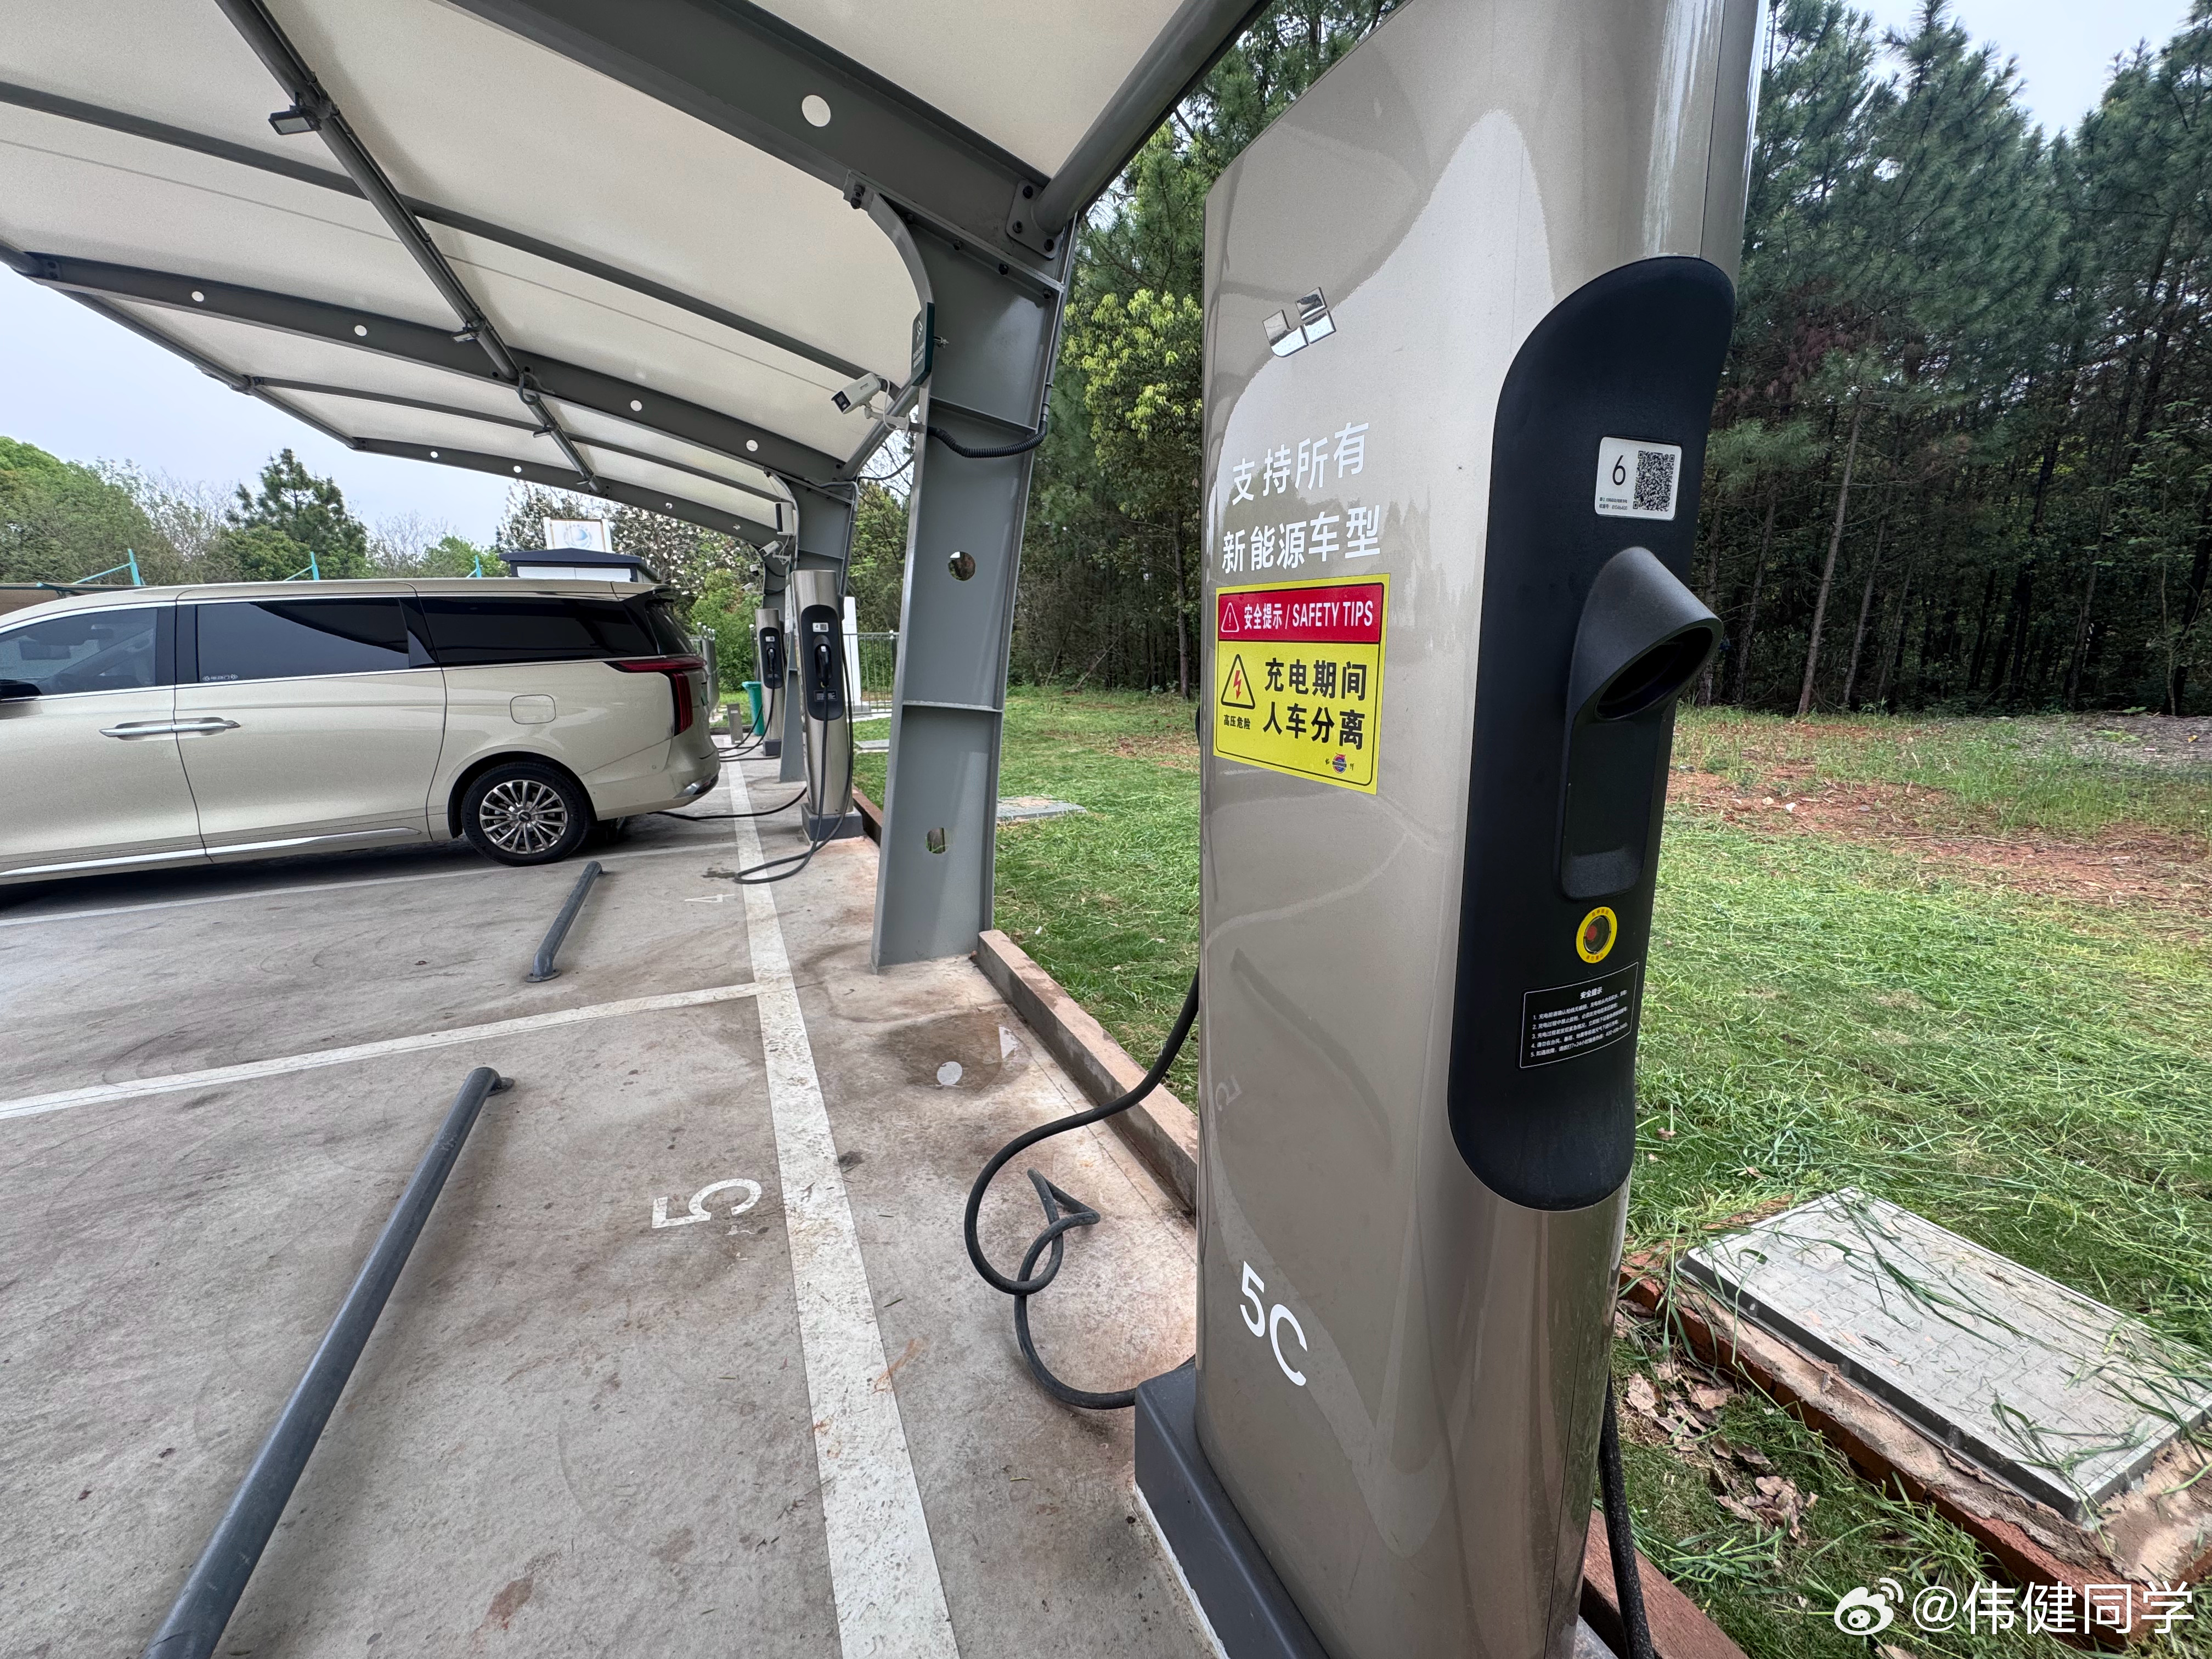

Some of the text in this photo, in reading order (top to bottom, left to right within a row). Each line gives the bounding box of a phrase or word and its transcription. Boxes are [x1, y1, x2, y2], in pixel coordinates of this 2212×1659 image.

[1232, 422, 1369, 506] 支持所有
[1612, 455, 1626, 486] 6
[1222, 505, 1381, 574] 新能源车型
[1244, 603, 1283, 630] 安全提示
[1293, 602, 1340, 627] SAFETY
[1343, 600, 1374, 627] TIPS
[1265, 657, 1368, 701] 充电期间
[1223, 714, 1251, 730] 高压危险
[1263, 702, 1365, 750] 人车分离
[685, 893, 735, 902] 4
[652, 1178, 762, 1228] 5
[1240, 1260, 1308, 1386] 5C
